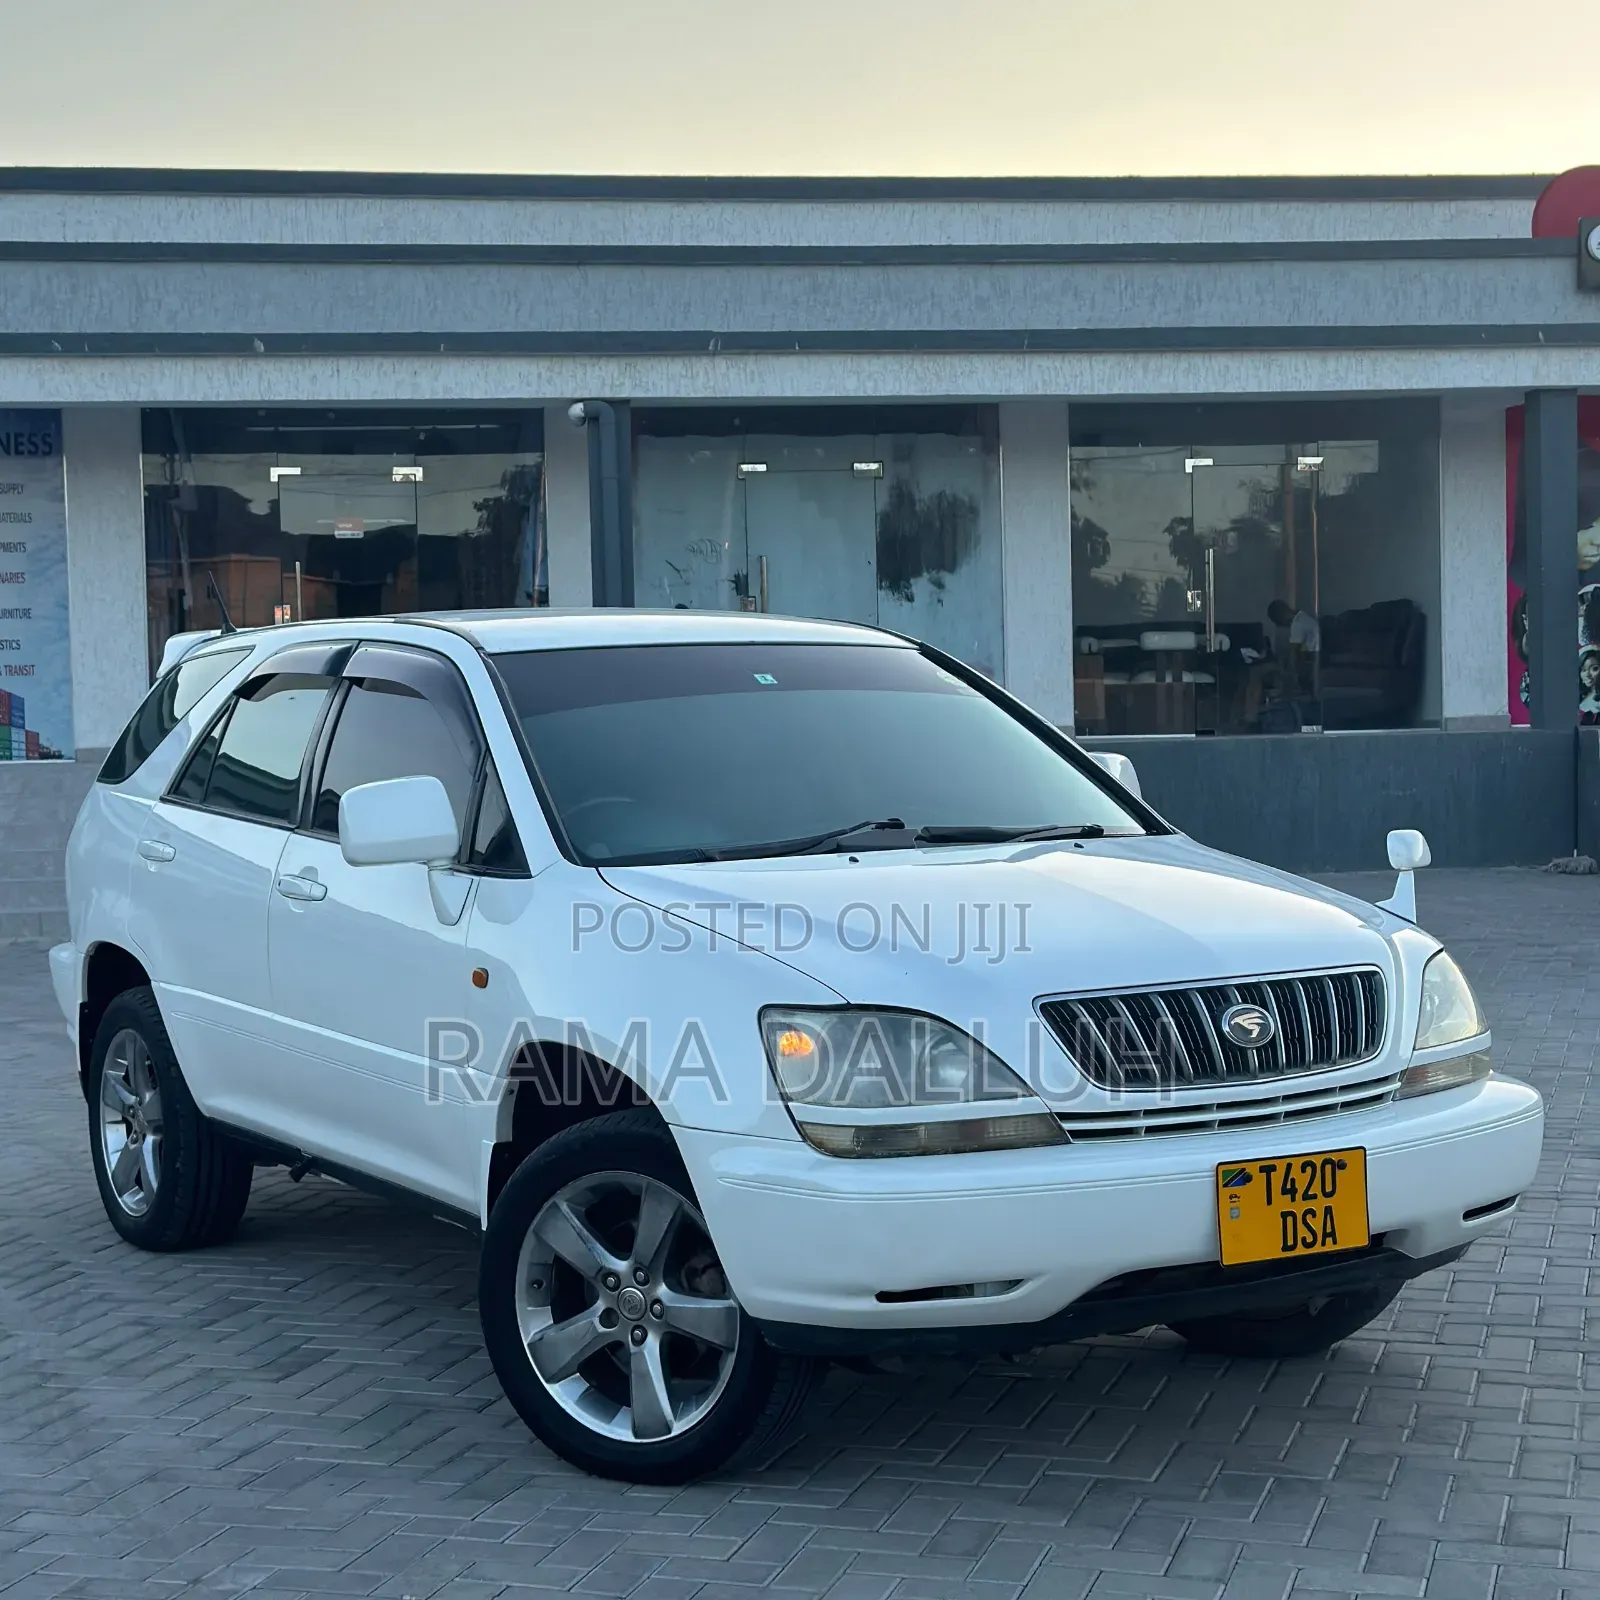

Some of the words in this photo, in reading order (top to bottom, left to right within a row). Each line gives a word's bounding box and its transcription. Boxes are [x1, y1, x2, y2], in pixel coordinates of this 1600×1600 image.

[0, 432, 53, 456] NESS
[4, 664, 36, 676] TRANSIT
[1258, 1157, 1337, 1206] T420
[1280, 1205, 1338, 1252] DSA
